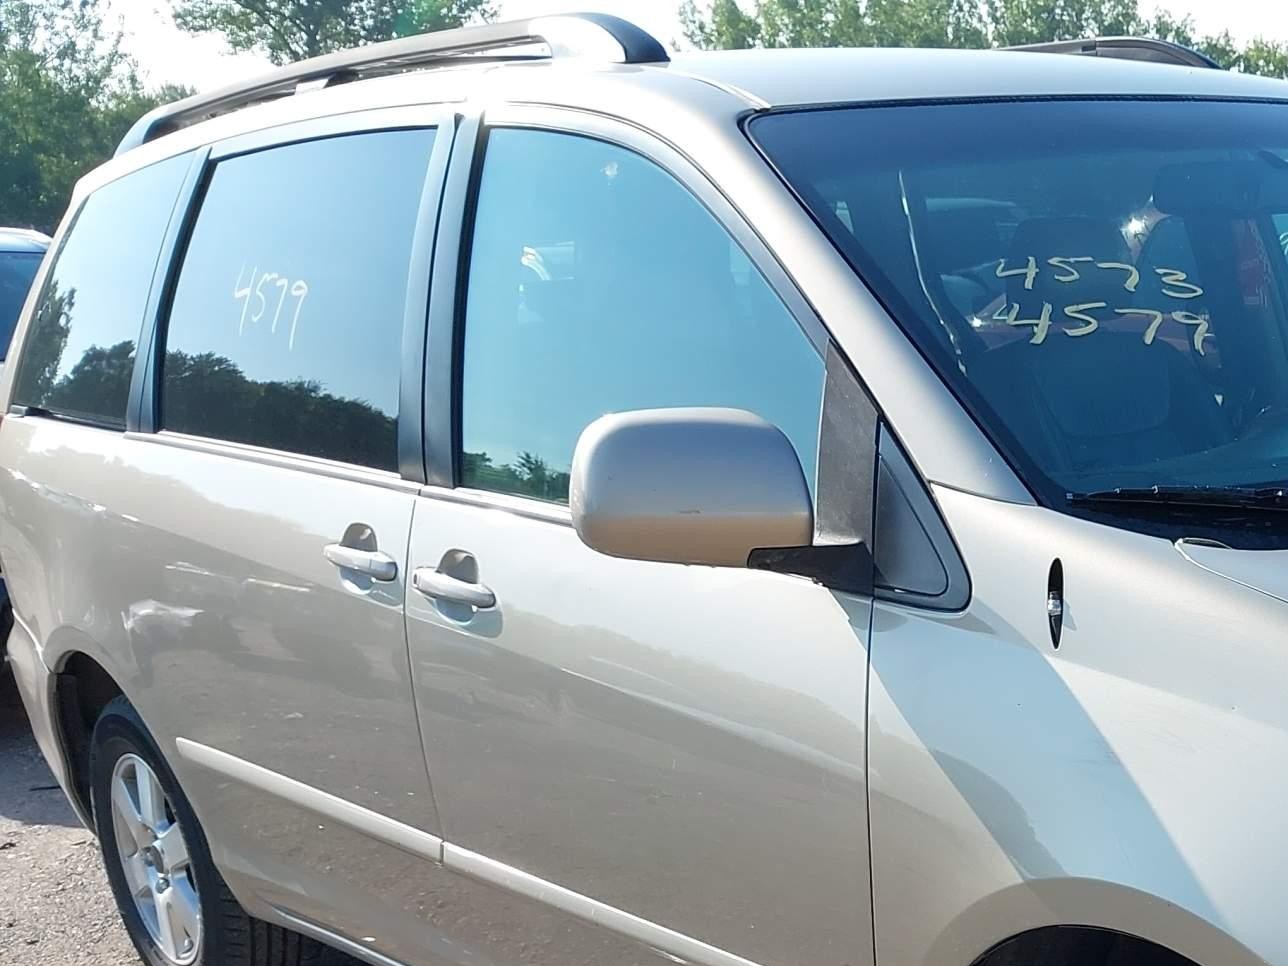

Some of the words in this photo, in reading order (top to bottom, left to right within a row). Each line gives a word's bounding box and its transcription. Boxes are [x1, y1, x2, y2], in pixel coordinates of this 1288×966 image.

[234, 258, 308, 352] 4579
[996, 256, 1204, 299] 4573
[1003, 300, 1209, 356] 4579
